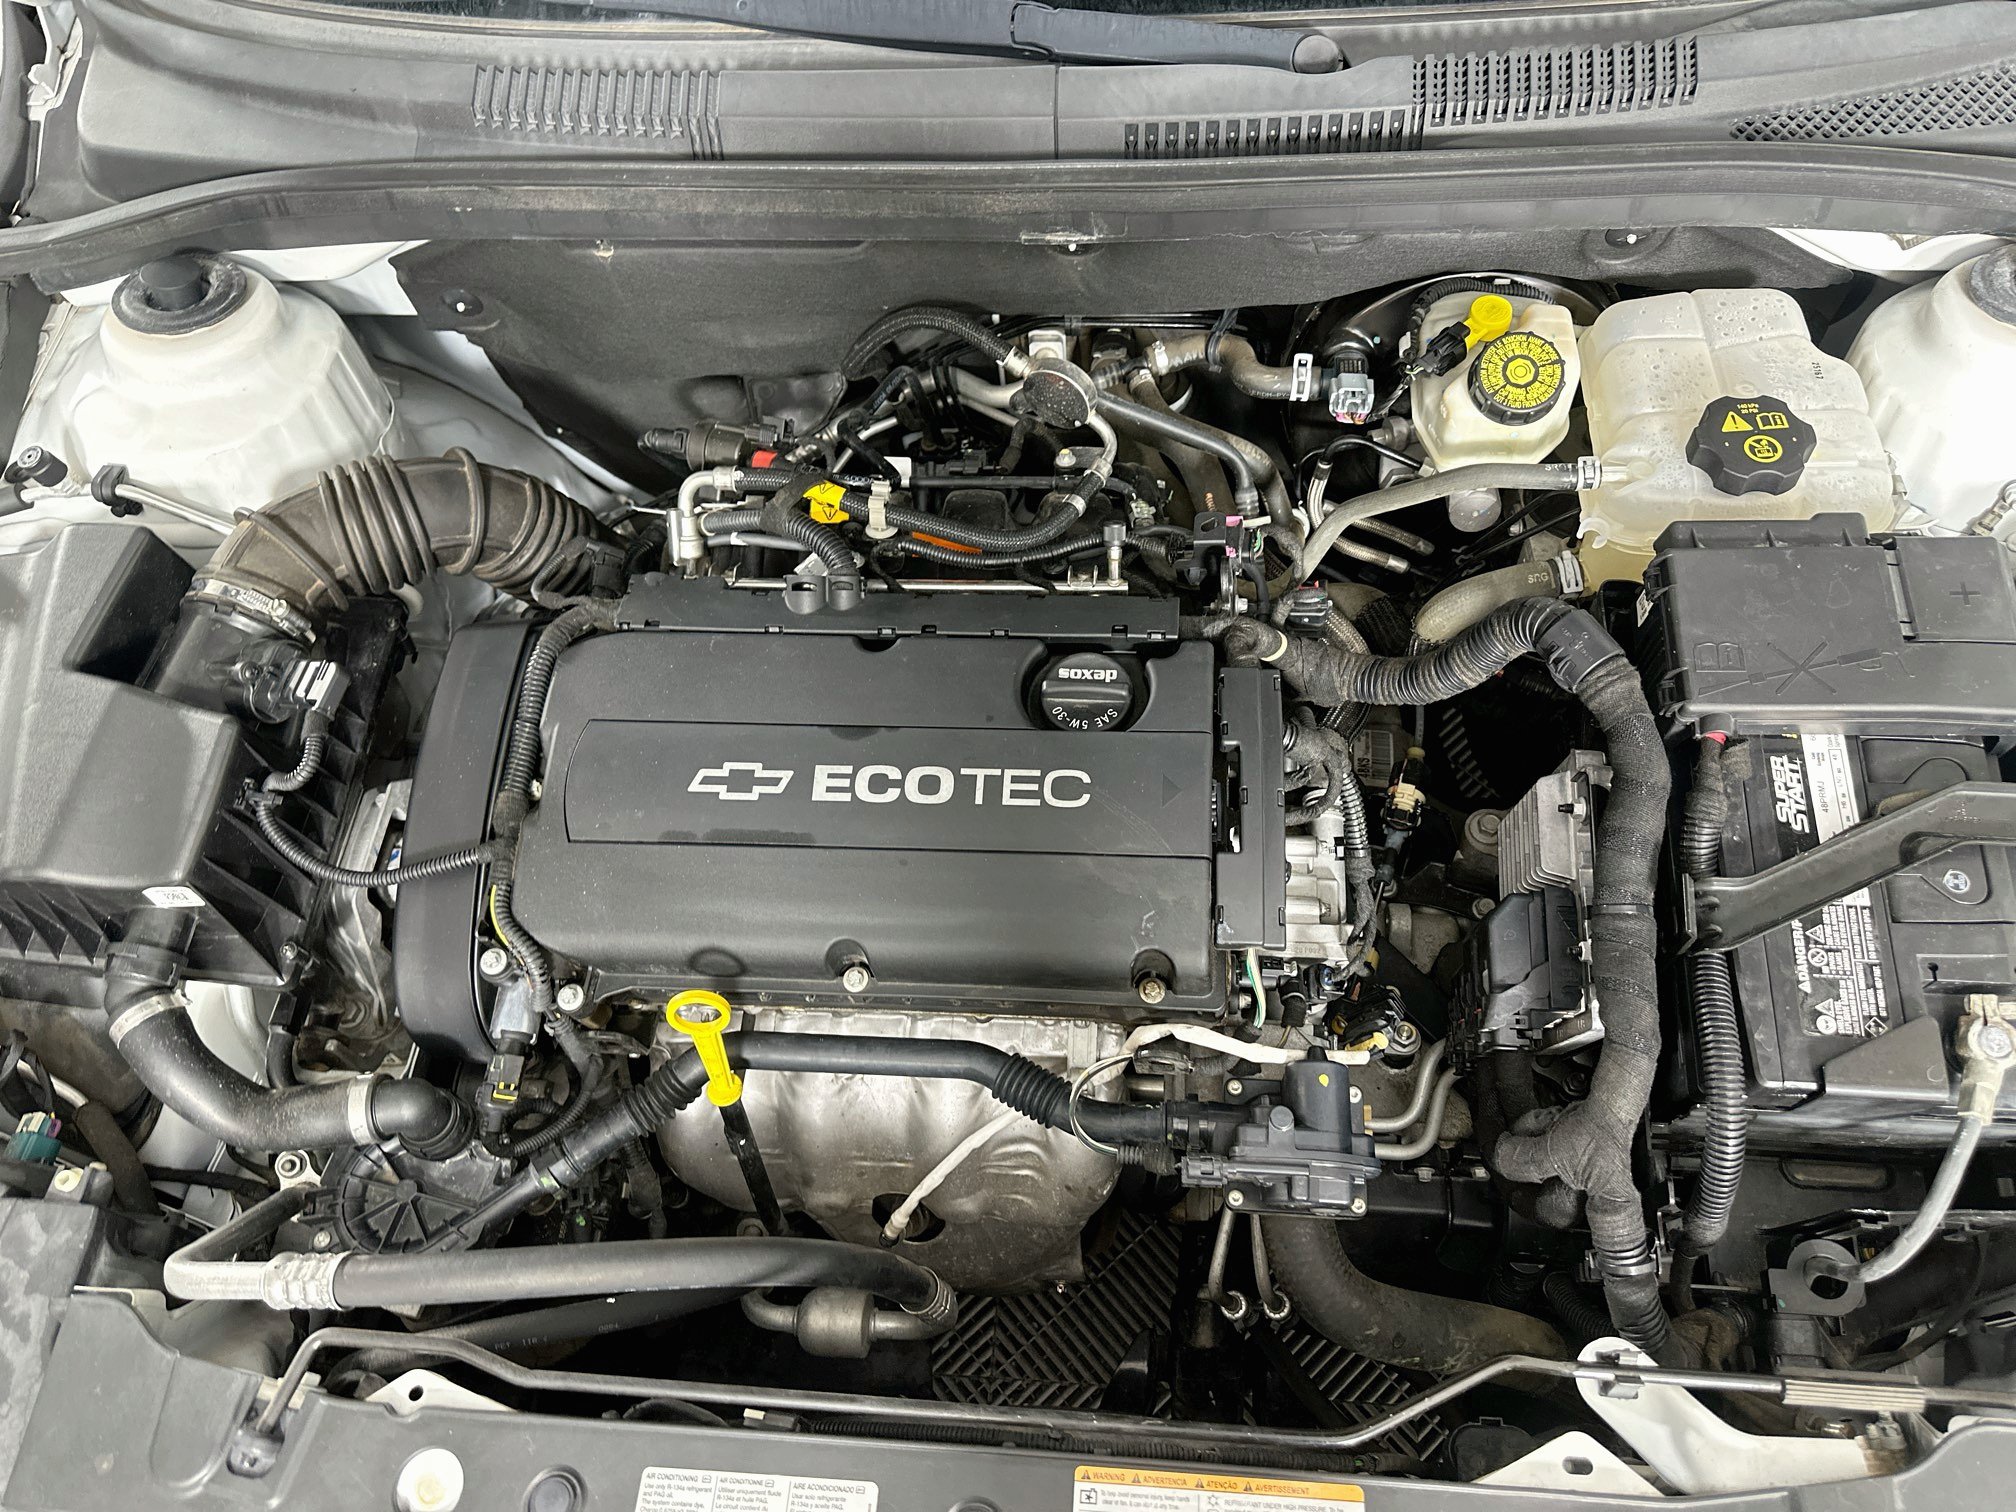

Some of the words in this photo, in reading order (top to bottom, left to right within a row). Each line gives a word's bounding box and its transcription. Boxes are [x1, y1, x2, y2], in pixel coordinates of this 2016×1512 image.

[1058, 667, 1118, 683] dexos
[1052, 706, 1089, 730] 5W-30
[1094, 708, 1118, 728] SAE
[811, 764, 1091, 808] ECOTEC
[1770, 755, 1792, 824] SUPER
[1782, 754, 1810, 834] START
[1817, 780, 1829, 813] 48PRMJ
[657, 1473, 699, 1482] CONDITIONING
[807, 1484, 855, 1493] ACONDICIONADO
[1093, 1473, 1125, 1481] WARNING
[1144, 1476, 1188, 1486] ADVERTENCIA
[1207, 1480, 1238, 1491] ATENÇÃO
[1255, 1484, 1310, 1495] AVERTISSEMENT
